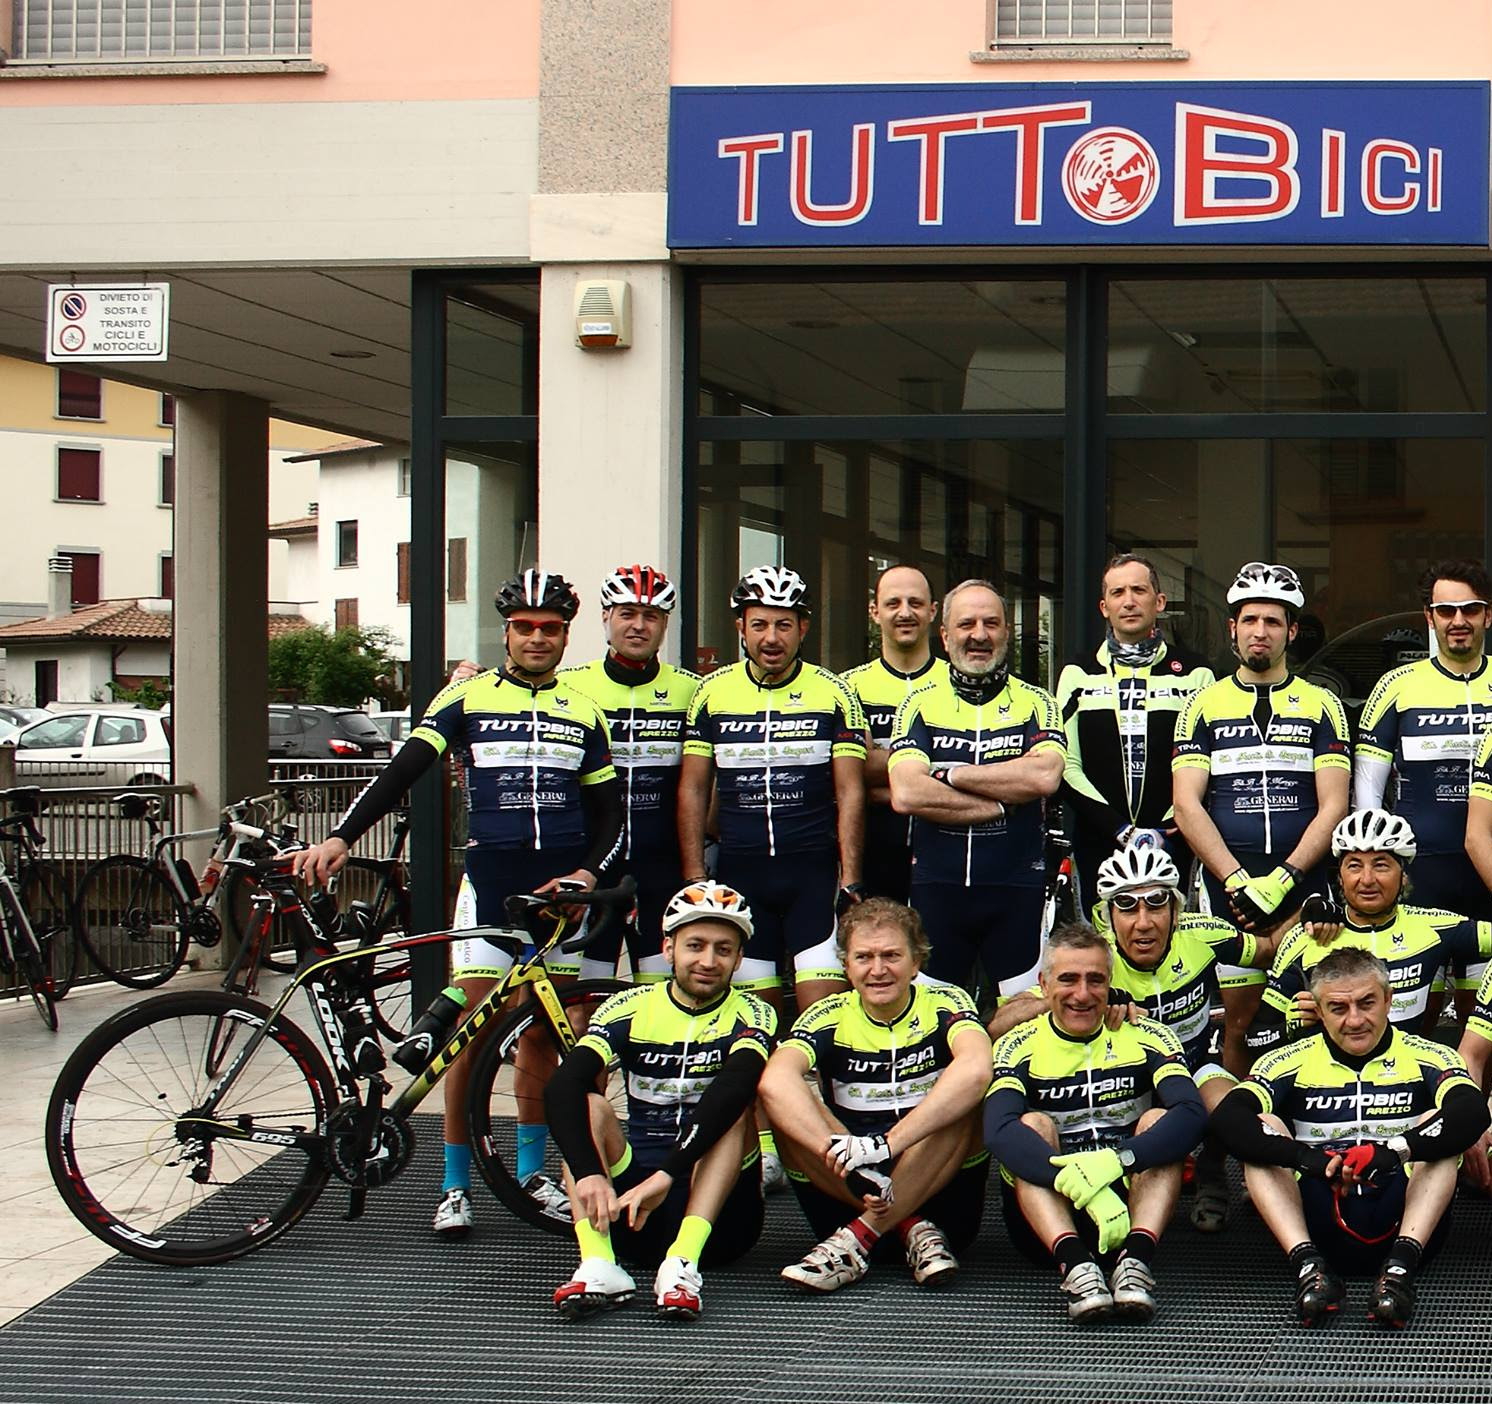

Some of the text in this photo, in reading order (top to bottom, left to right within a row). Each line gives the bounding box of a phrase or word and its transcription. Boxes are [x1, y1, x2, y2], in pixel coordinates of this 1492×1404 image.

[99, 293, 140, 302] DIVIETO
[104, 307, 148, 315] SOSTA E
[100, 320, 152, 328] TRANSITO
[104, 331, 145, 339] CICLI E
[93, 343, 157, 351] MOTOCICLI
[479, 719, 585, 739] TUTTOBICI
[607, 718, 682, 731] TTOBICI
[719, 719, 819, 734] TUTTOBICI
[932, 734, 1023, 752] TUTTOBICI
[1178, 743, 1202, 752] TINA
[1150, 982, 1204, 1018] TOBICI
[1475, 1005, 1492, 1018] TINA
[311, 982, 350, 1076] LOOK
[1038, 1076, 1135, 1100] TUTTOBICI
[1305, 1092, 1412, 1111] TUTTOBICI
[1365, 1106, 1411, 1116] AREZZO
[252, 1131, 297, 1145] 695
